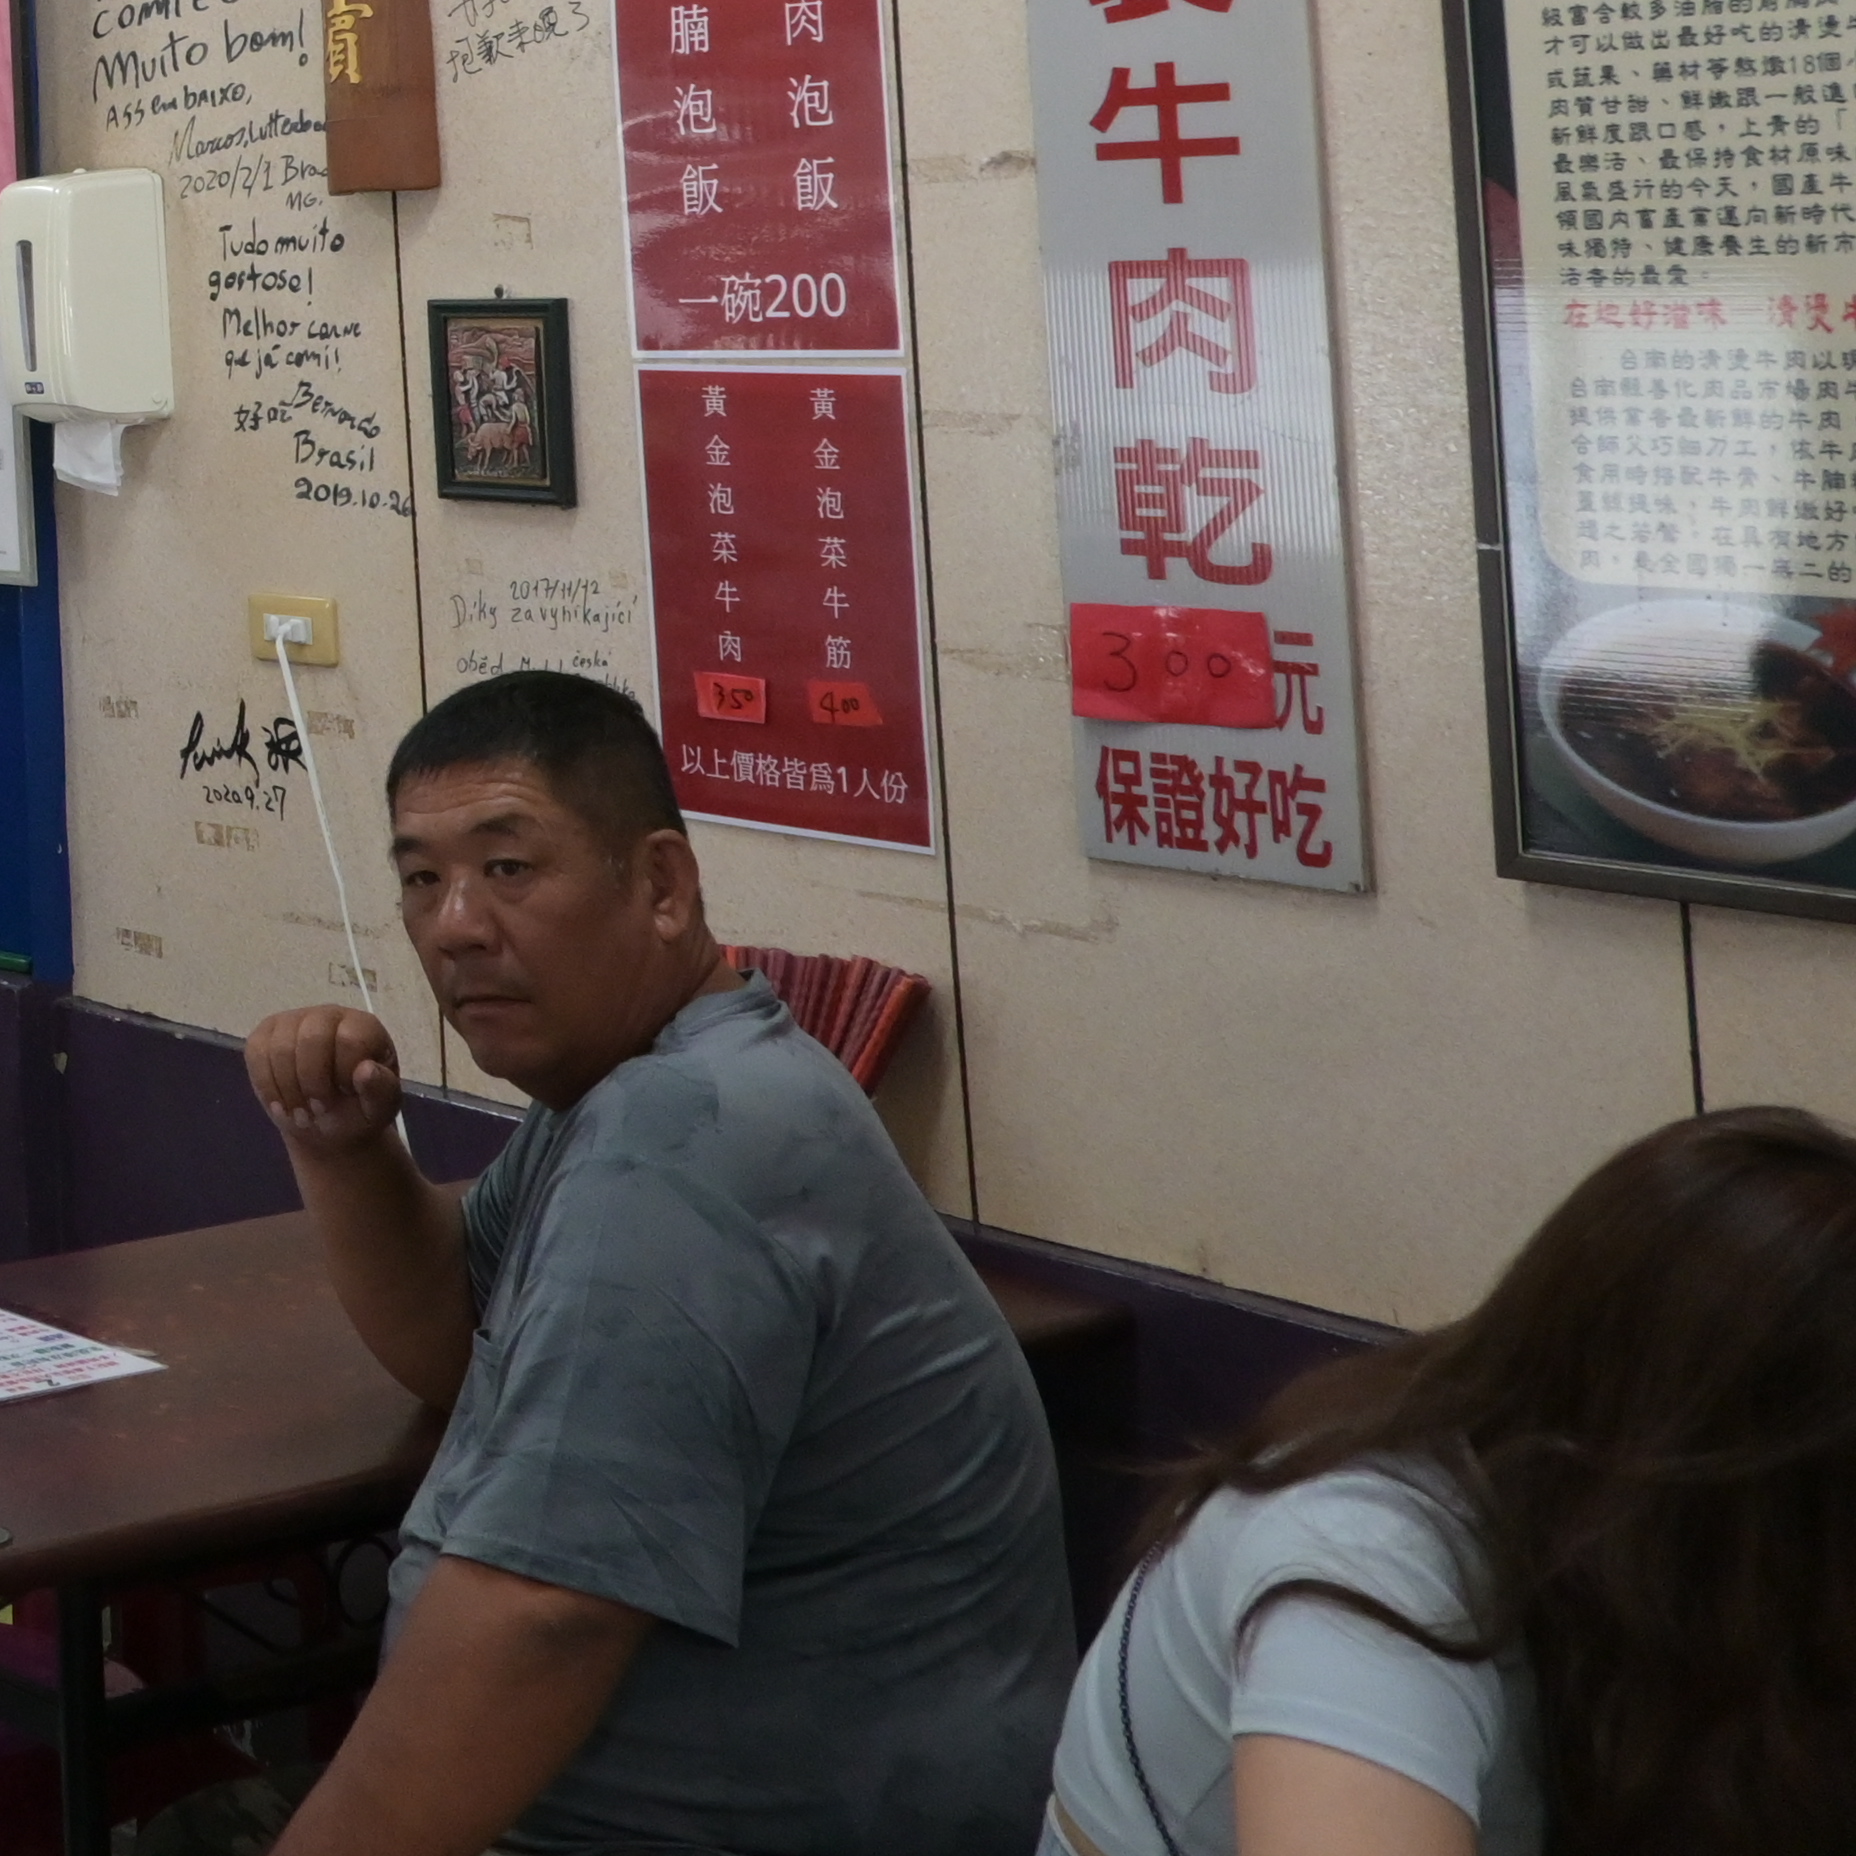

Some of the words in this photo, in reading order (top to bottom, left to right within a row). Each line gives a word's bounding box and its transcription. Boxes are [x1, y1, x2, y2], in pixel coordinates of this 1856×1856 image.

[678, 271, 847, 322] 一碗200
[701, 385, 743, 663] 黃金泡菜牛肉
[809, 387, 853, 670] 黃金泡菜牛筋
[1100, 628, 1233, 693] 300
[1093, 744, 1335, 871] 保證好吃
